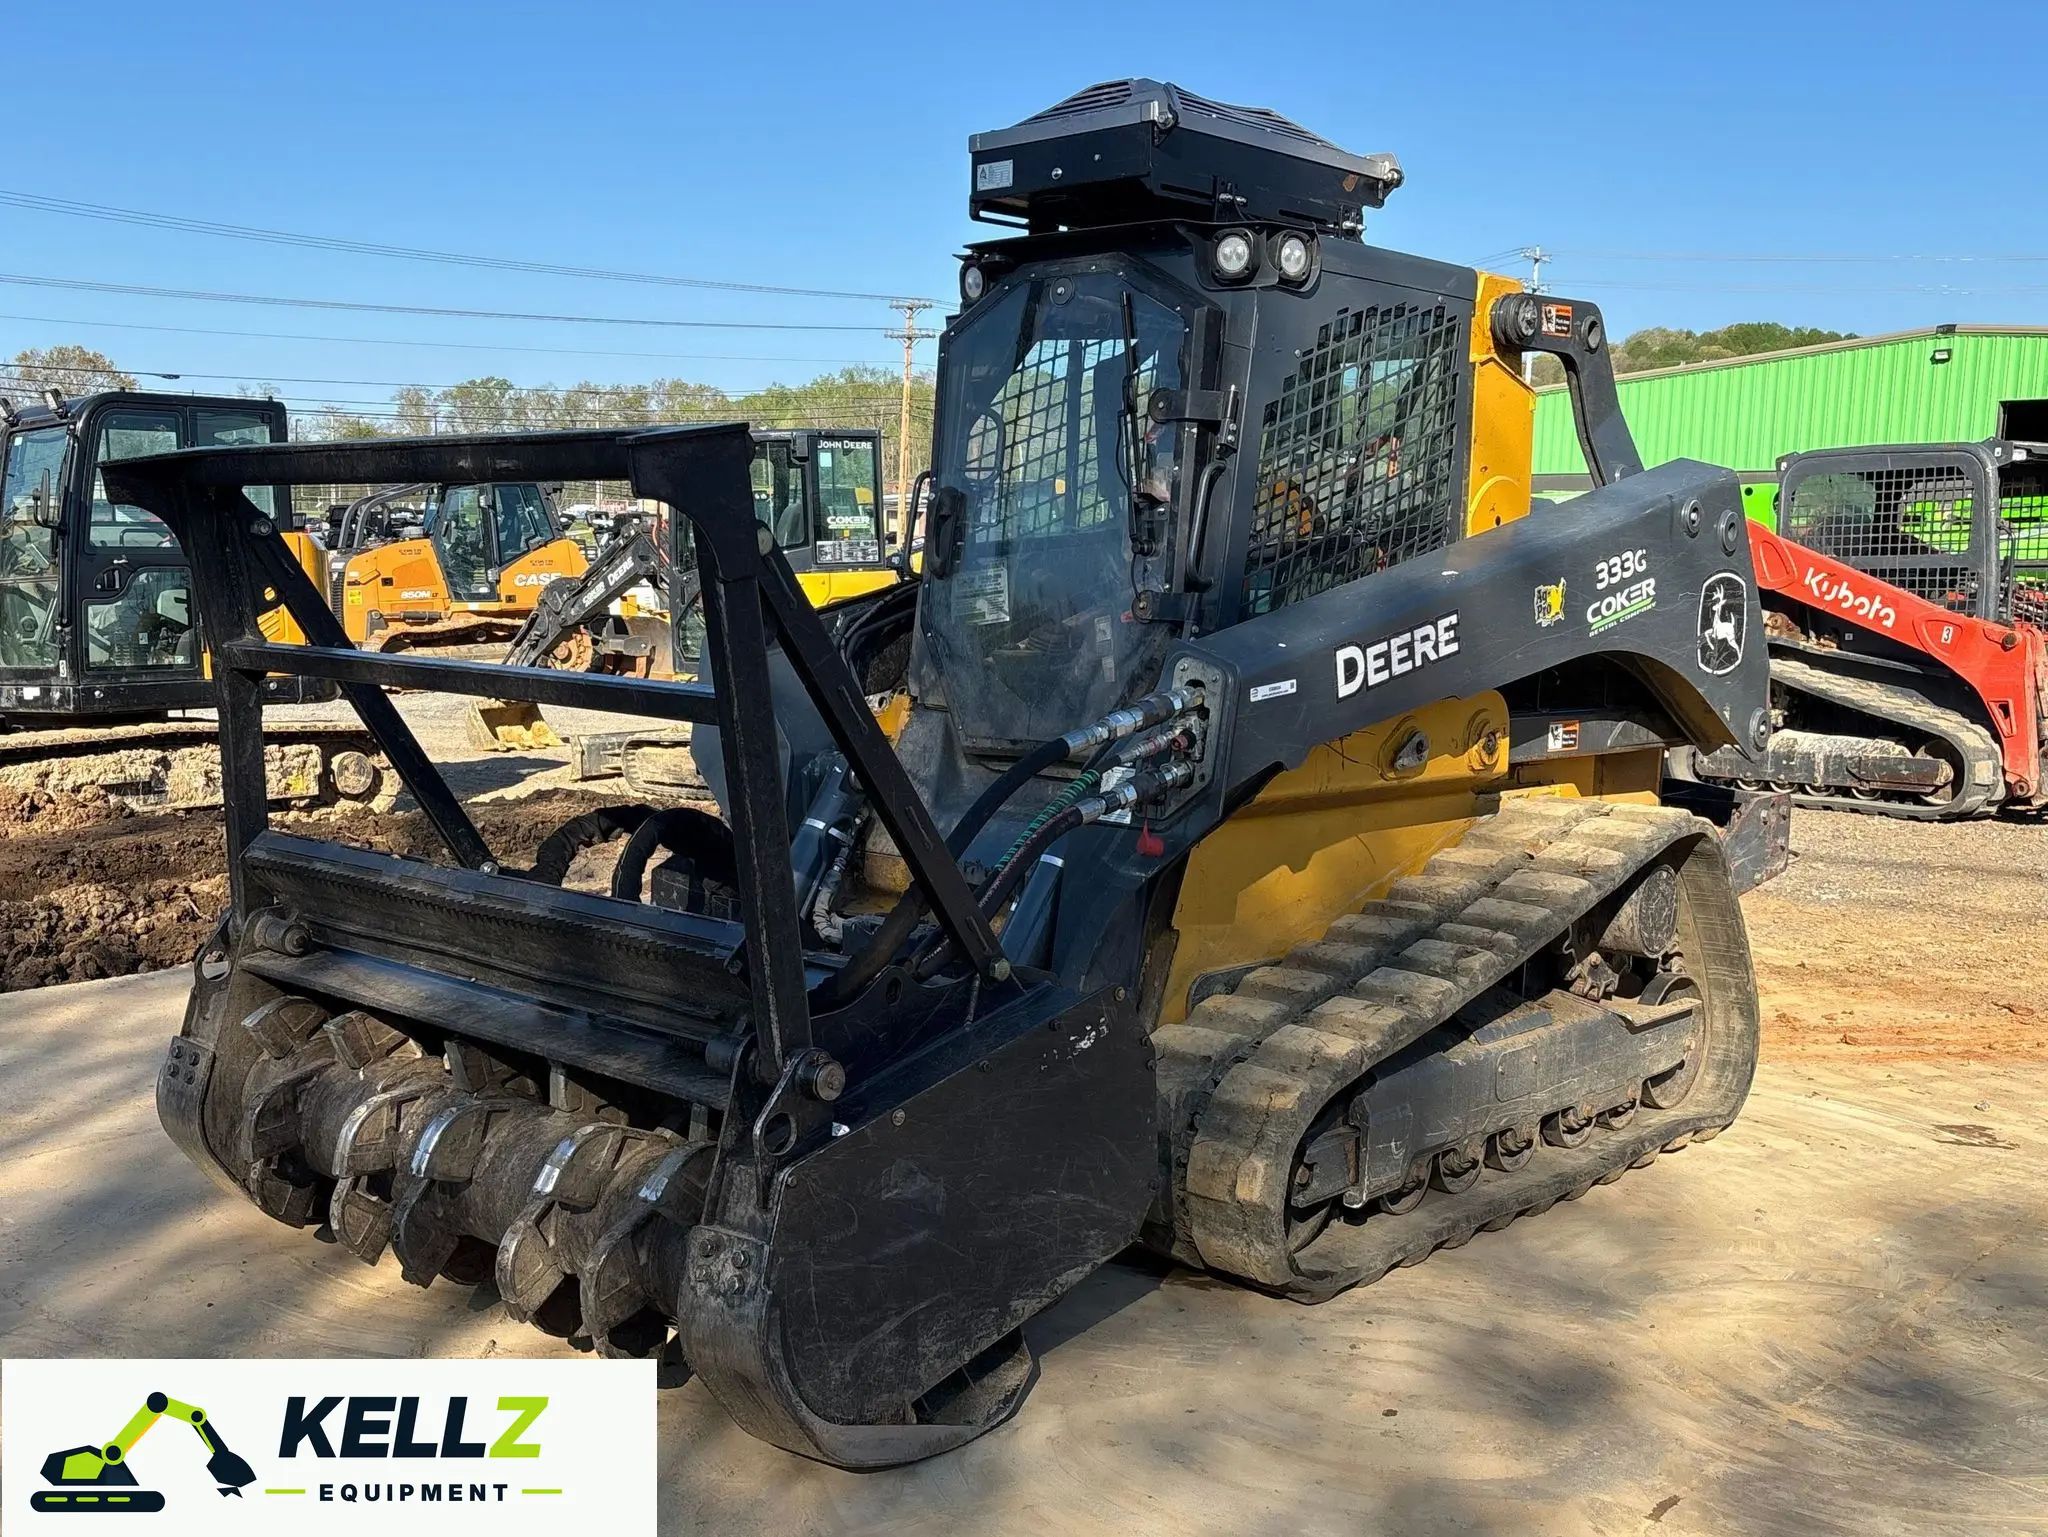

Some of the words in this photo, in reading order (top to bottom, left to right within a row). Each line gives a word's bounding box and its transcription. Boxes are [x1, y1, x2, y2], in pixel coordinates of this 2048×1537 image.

[817, 440, 842, 449] JOHN
[843, 440, 873, 449] DEERE
[827, 516, 870, 524] COKER
[607, 556, 634, 586] DEERE
[1596, 549, 1647, 590] 333G
[1586, 578, 1657, 623] COKER
[1804, 567, 1896, 628] Kubota
[1589, 620, 1618, 637] RENTAL
[1619, 601, 1657, 622] COMPANY
[1943, 628, 1951, 642] 3
[1336, 614, 1459, 699] DEERE
